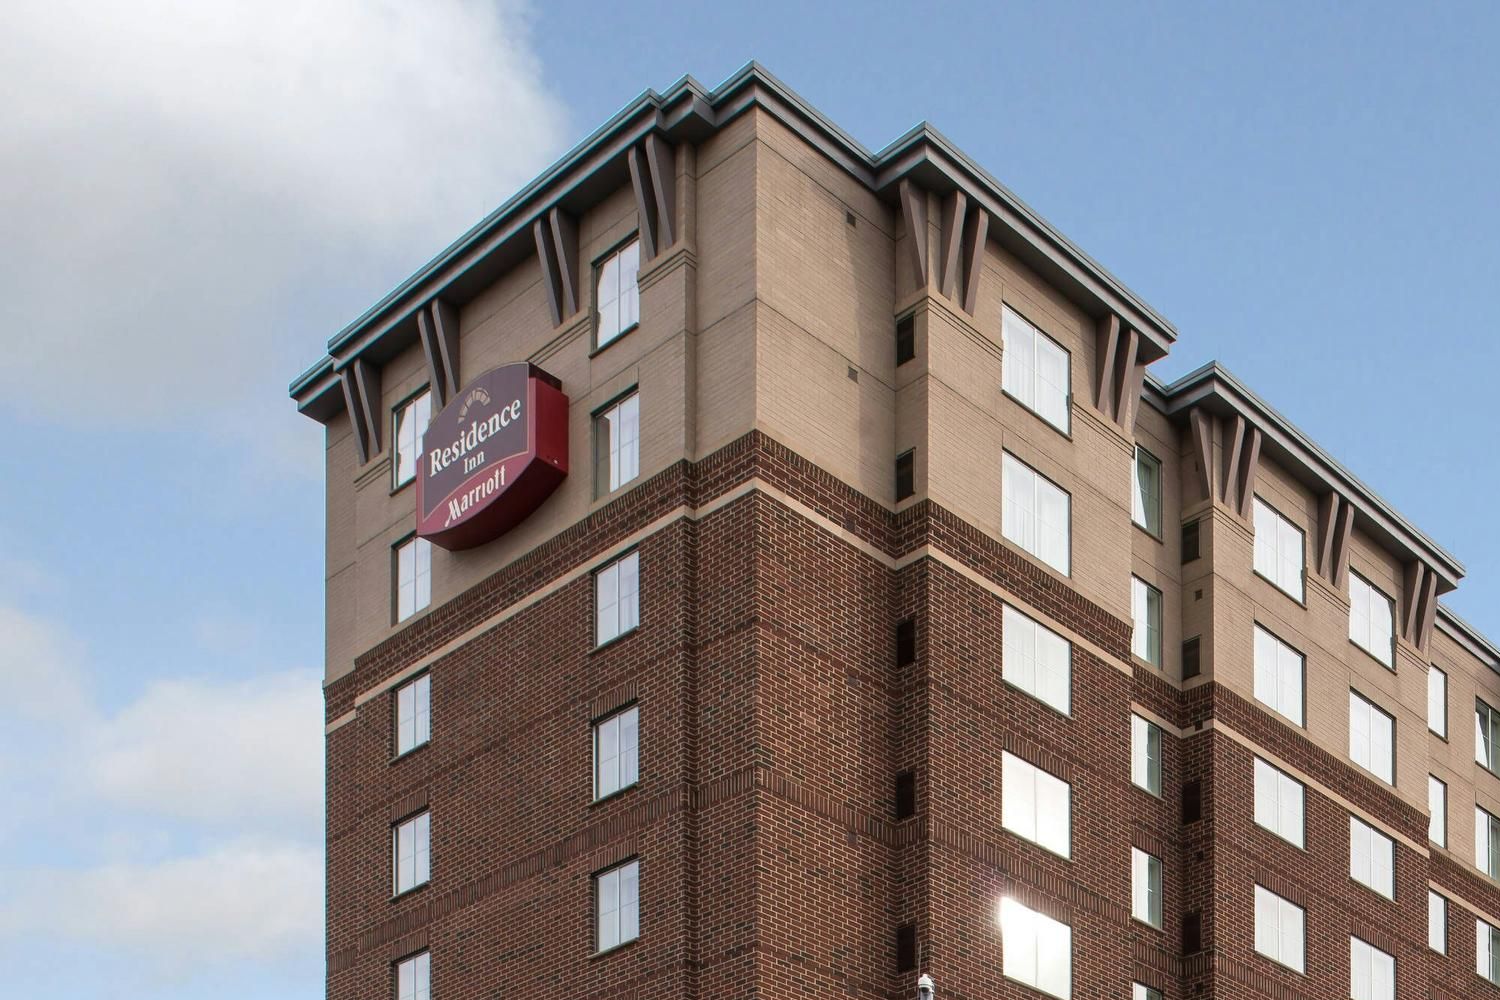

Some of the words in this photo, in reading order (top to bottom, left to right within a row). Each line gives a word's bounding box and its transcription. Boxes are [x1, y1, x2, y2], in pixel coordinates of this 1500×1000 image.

[429, 399, 521, 478] Residence
[463, 451, 485, 475] Inn
[445, 465, 506, 527] Marriott
